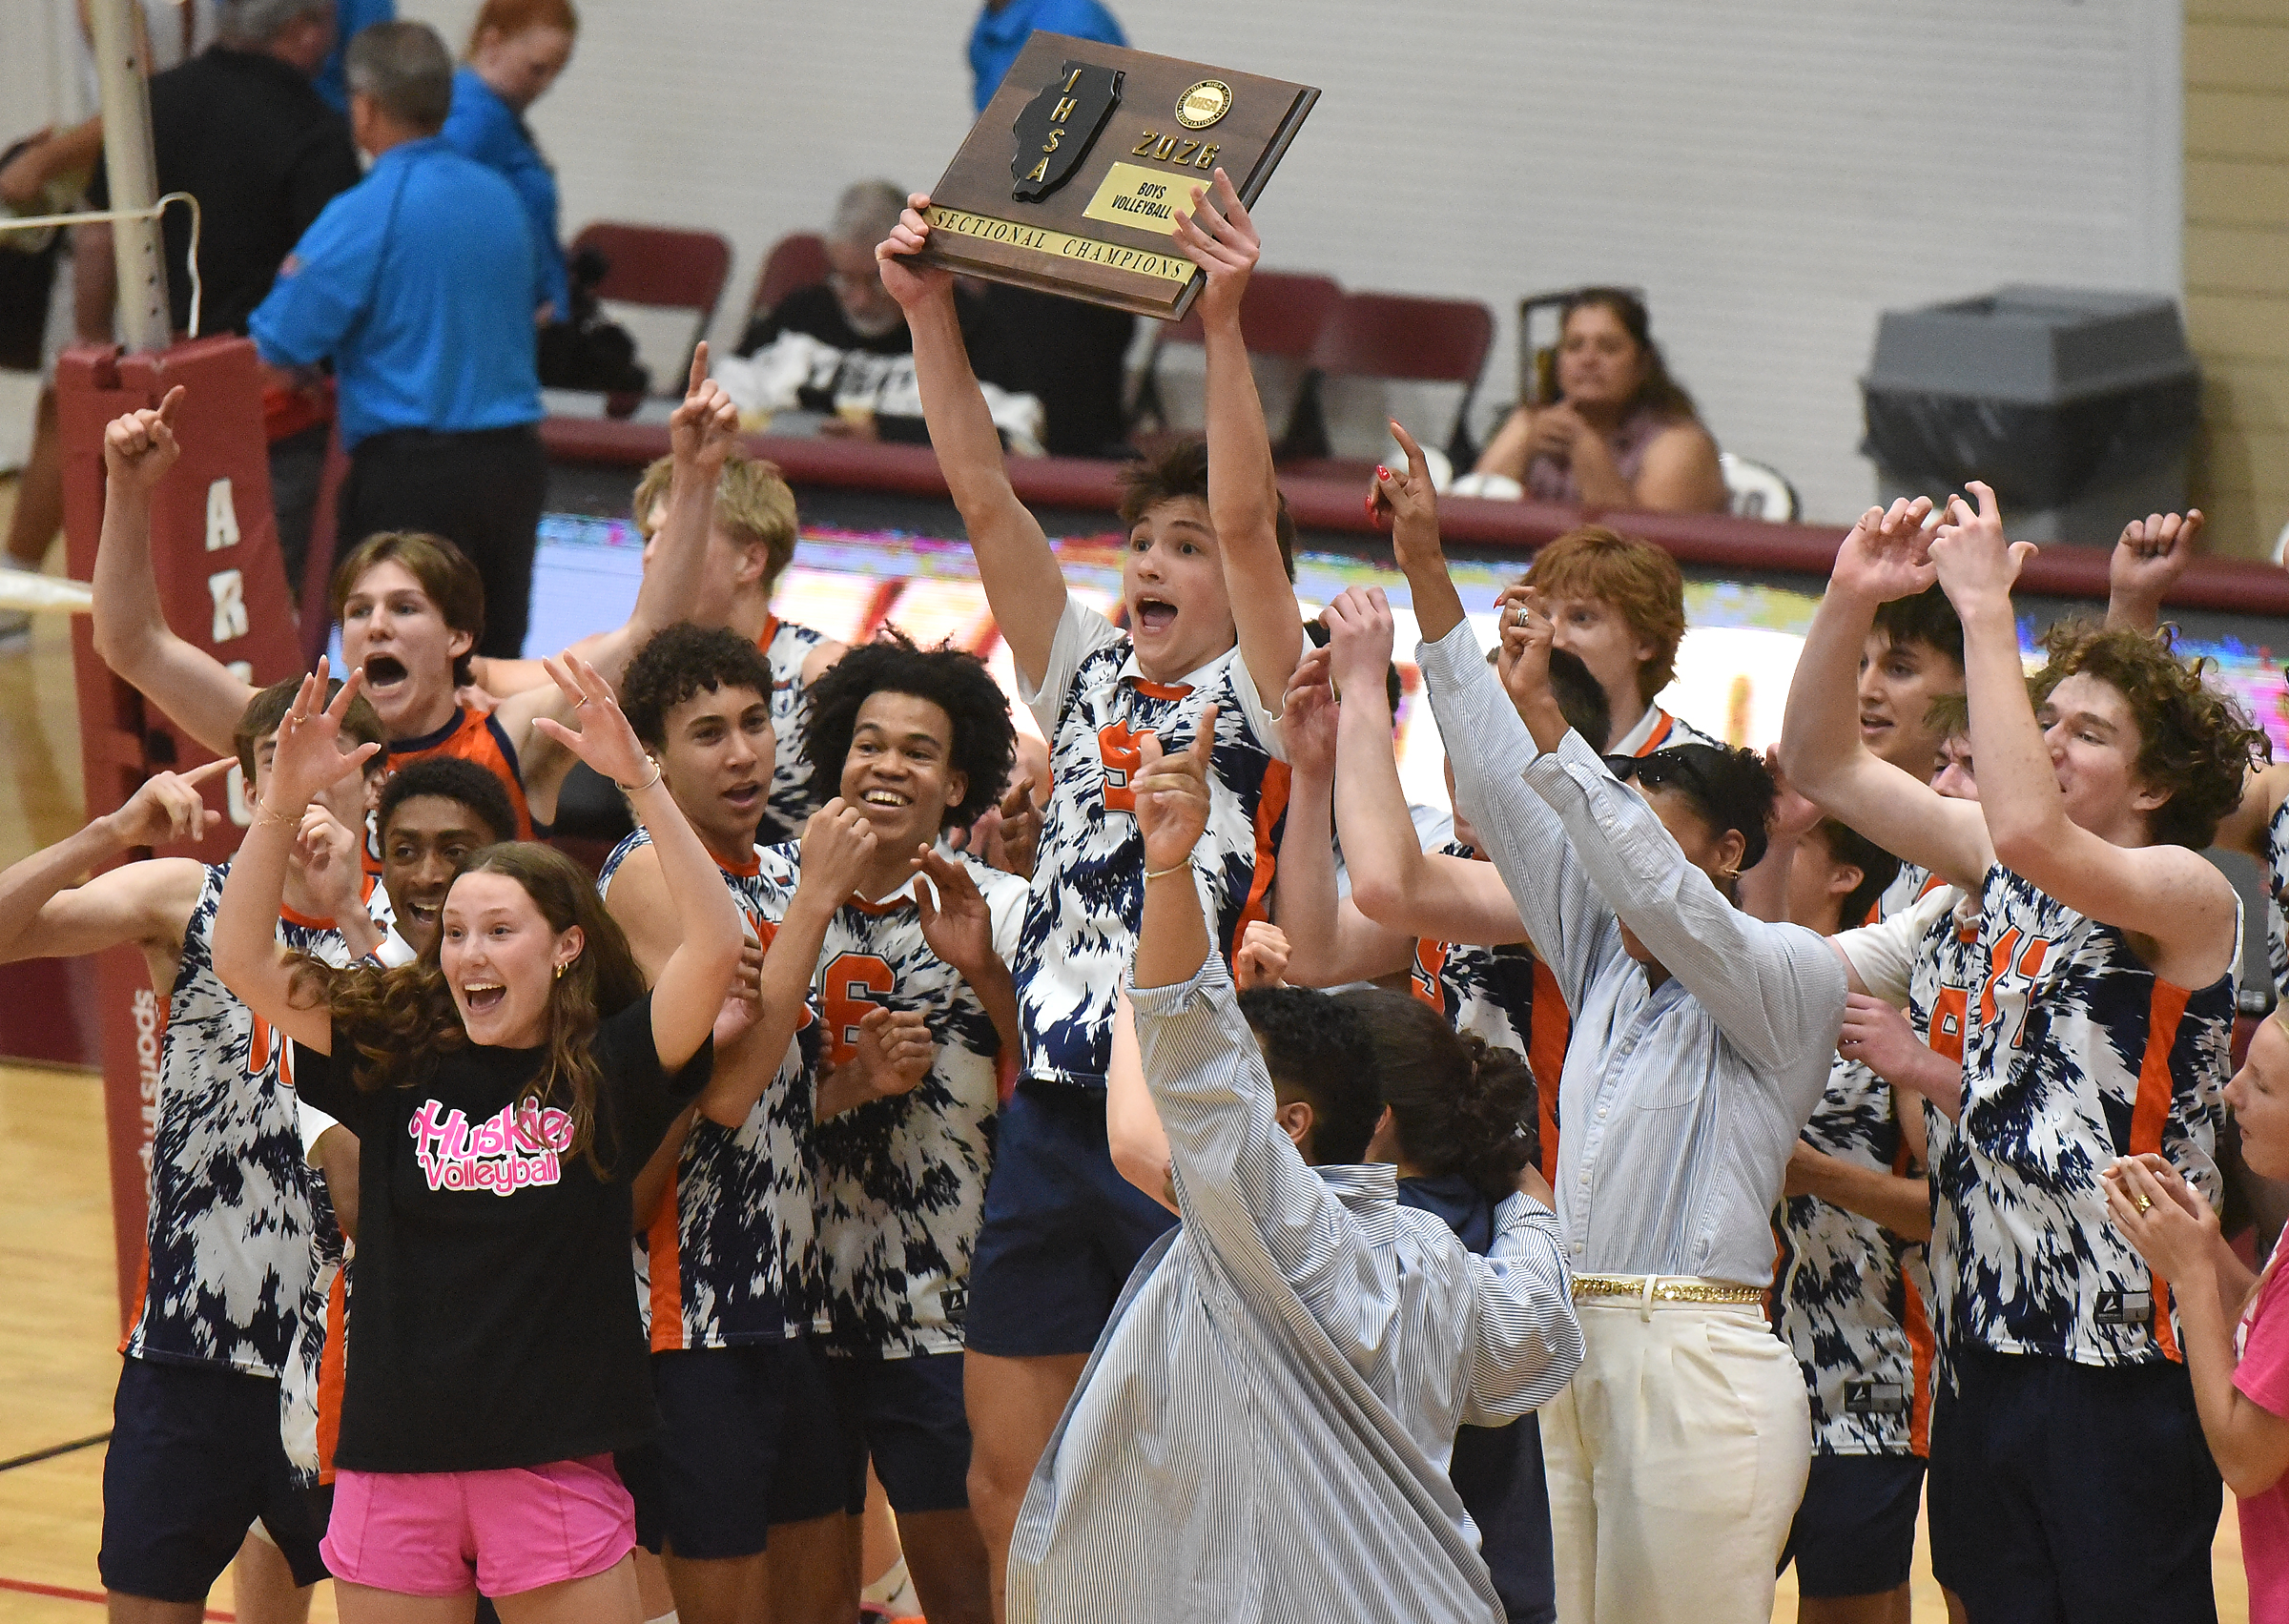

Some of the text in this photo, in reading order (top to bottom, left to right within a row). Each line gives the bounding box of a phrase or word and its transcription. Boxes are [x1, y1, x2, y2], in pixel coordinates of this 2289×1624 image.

[1026, 69, 1082, 183] IHSA
[1132, 130, 1220, 170] 2026
[1111, 194, 1173, 219] VOLLEYBALL
[1137, 181, 1167, 199] BOYS
[934, 210, 1046, 249] SECTIONAL
[1062, 238, 1185, 278] CHAMPIONS
[822, 950, 896, 1068] 6
[410, 1098, 574, 1161] Huskie
[419, 1153, 560, 1193] Volleyball
